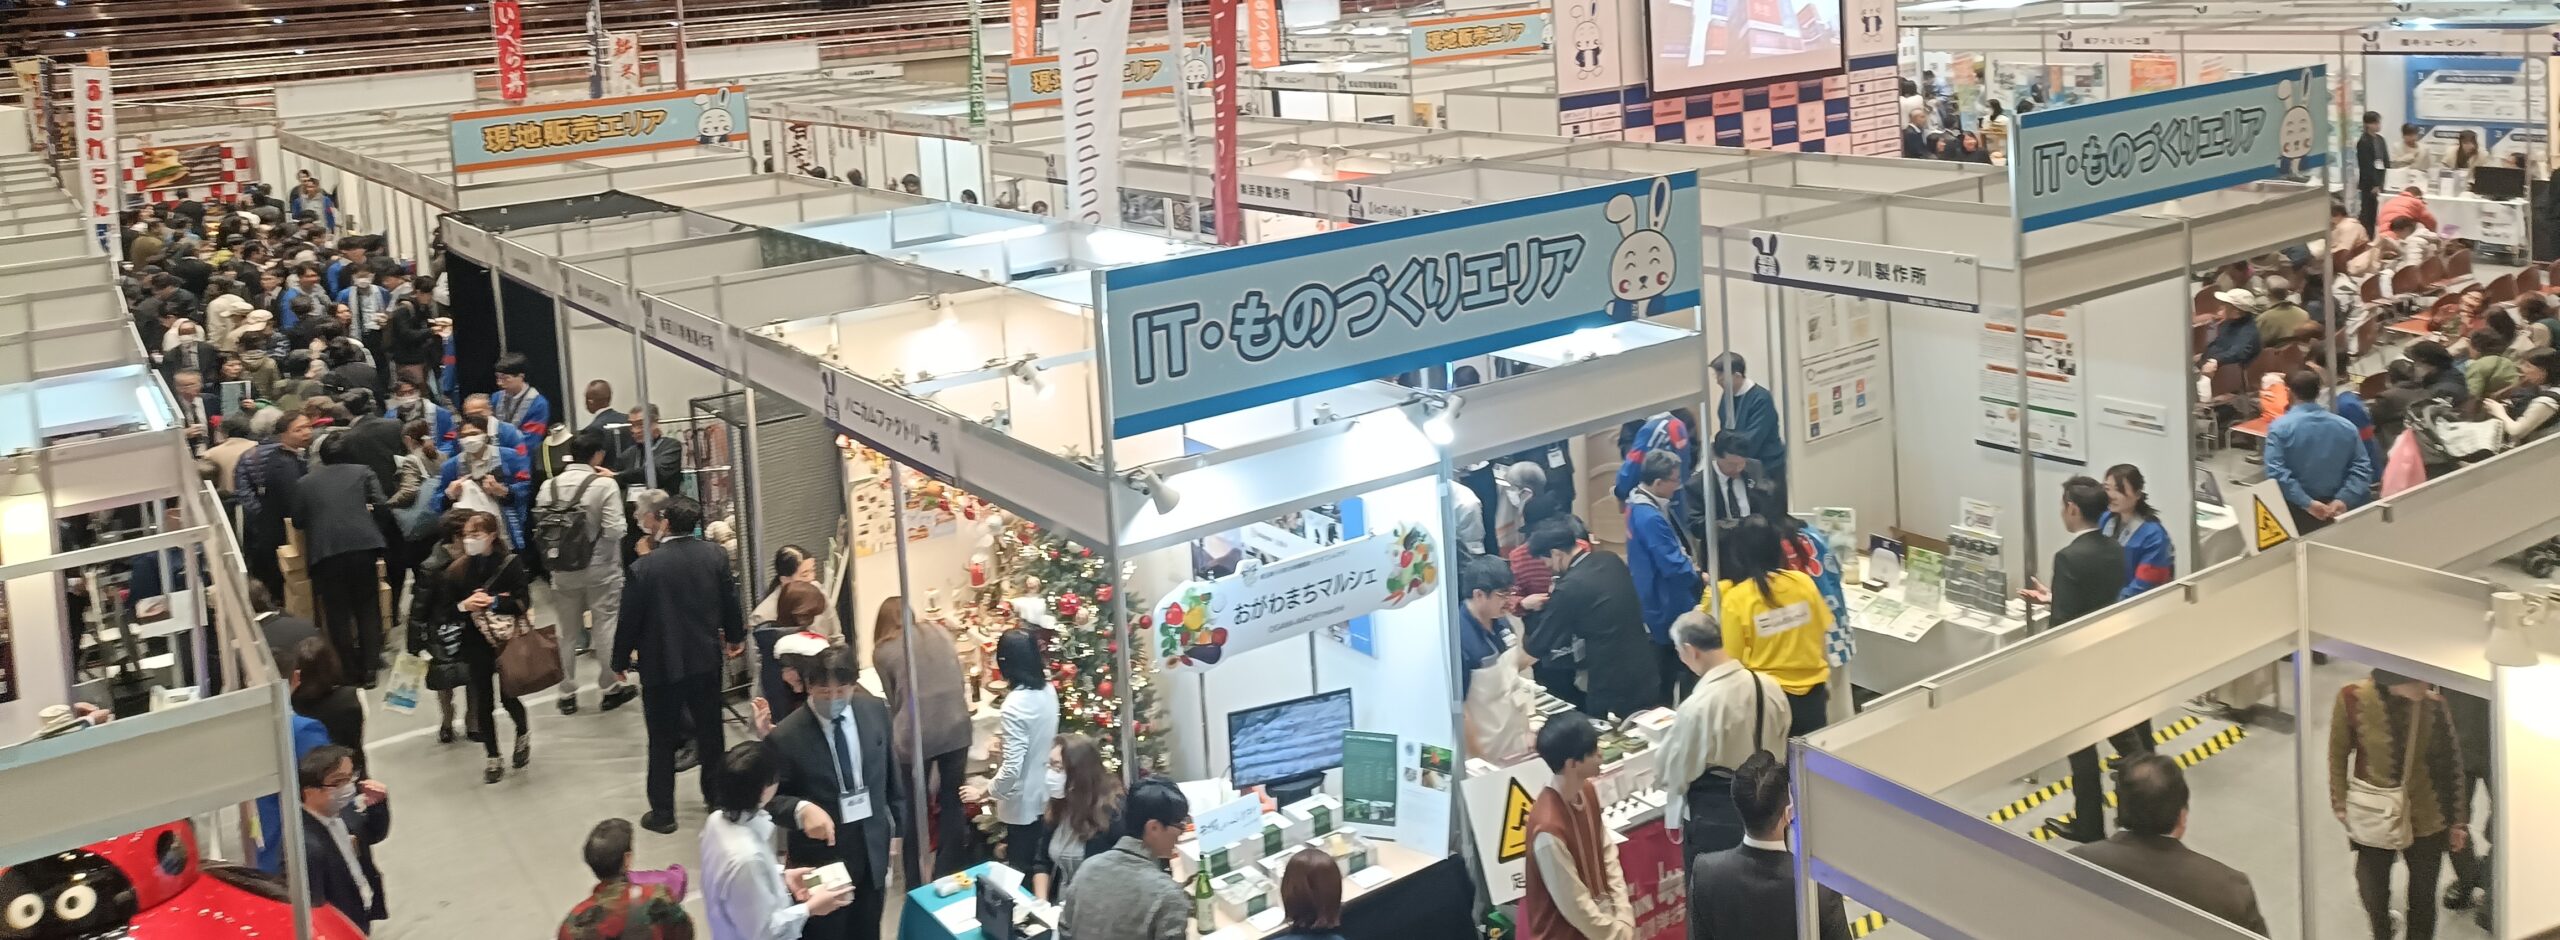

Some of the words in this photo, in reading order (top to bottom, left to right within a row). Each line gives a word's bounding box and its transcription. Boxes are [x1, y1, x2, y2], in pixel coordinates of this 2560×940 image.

[497, 4, 525, 95] いくら丼
[1426, 22, 1526, 52] 現地販売エリア
[482, 107, 668, 153] 現地販売エリア
[1233, 568, 1378, 625] おがわまちマルシェ
